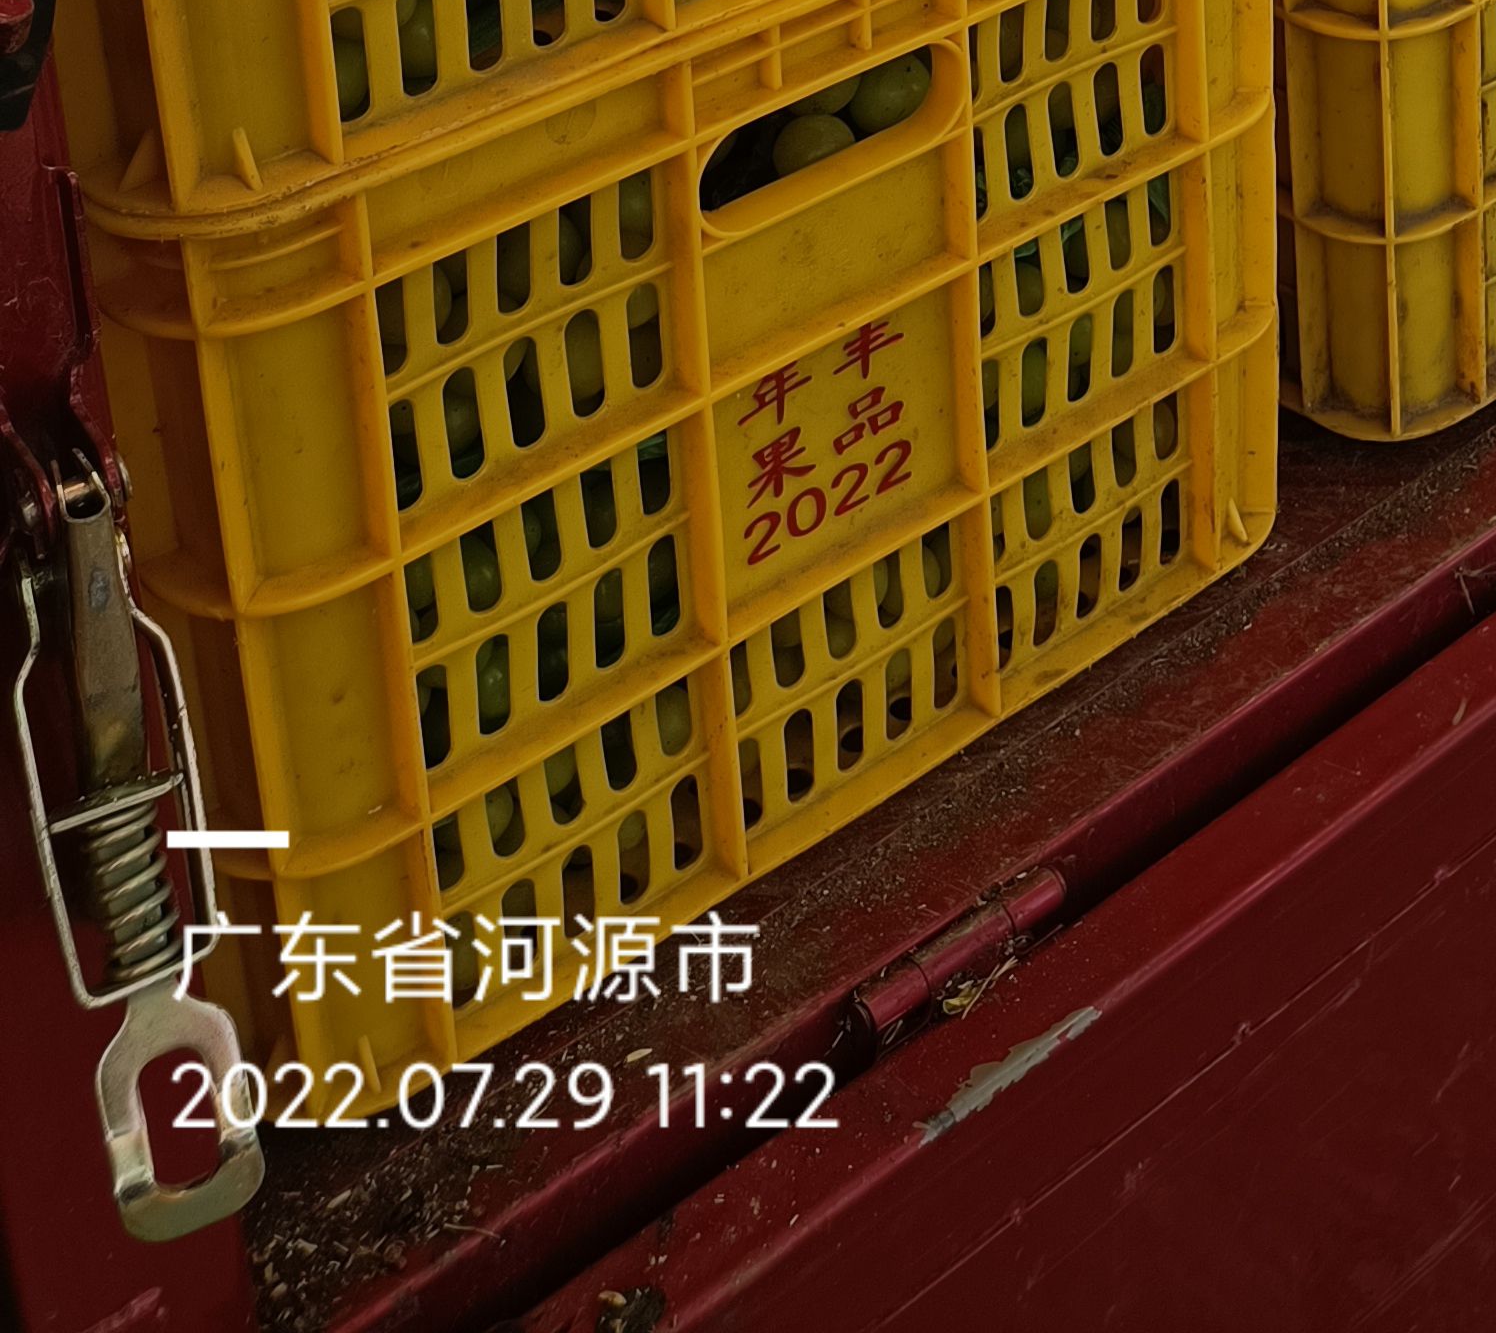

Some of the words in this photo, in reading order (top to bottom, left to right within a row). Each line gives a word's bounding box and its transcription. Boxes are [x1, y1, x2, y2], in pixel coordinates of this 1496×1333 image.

[736, 320, 905, 427] 年丰
[742, 438, 913, 567] 2022
[746, 385, 905, 510] 果品
